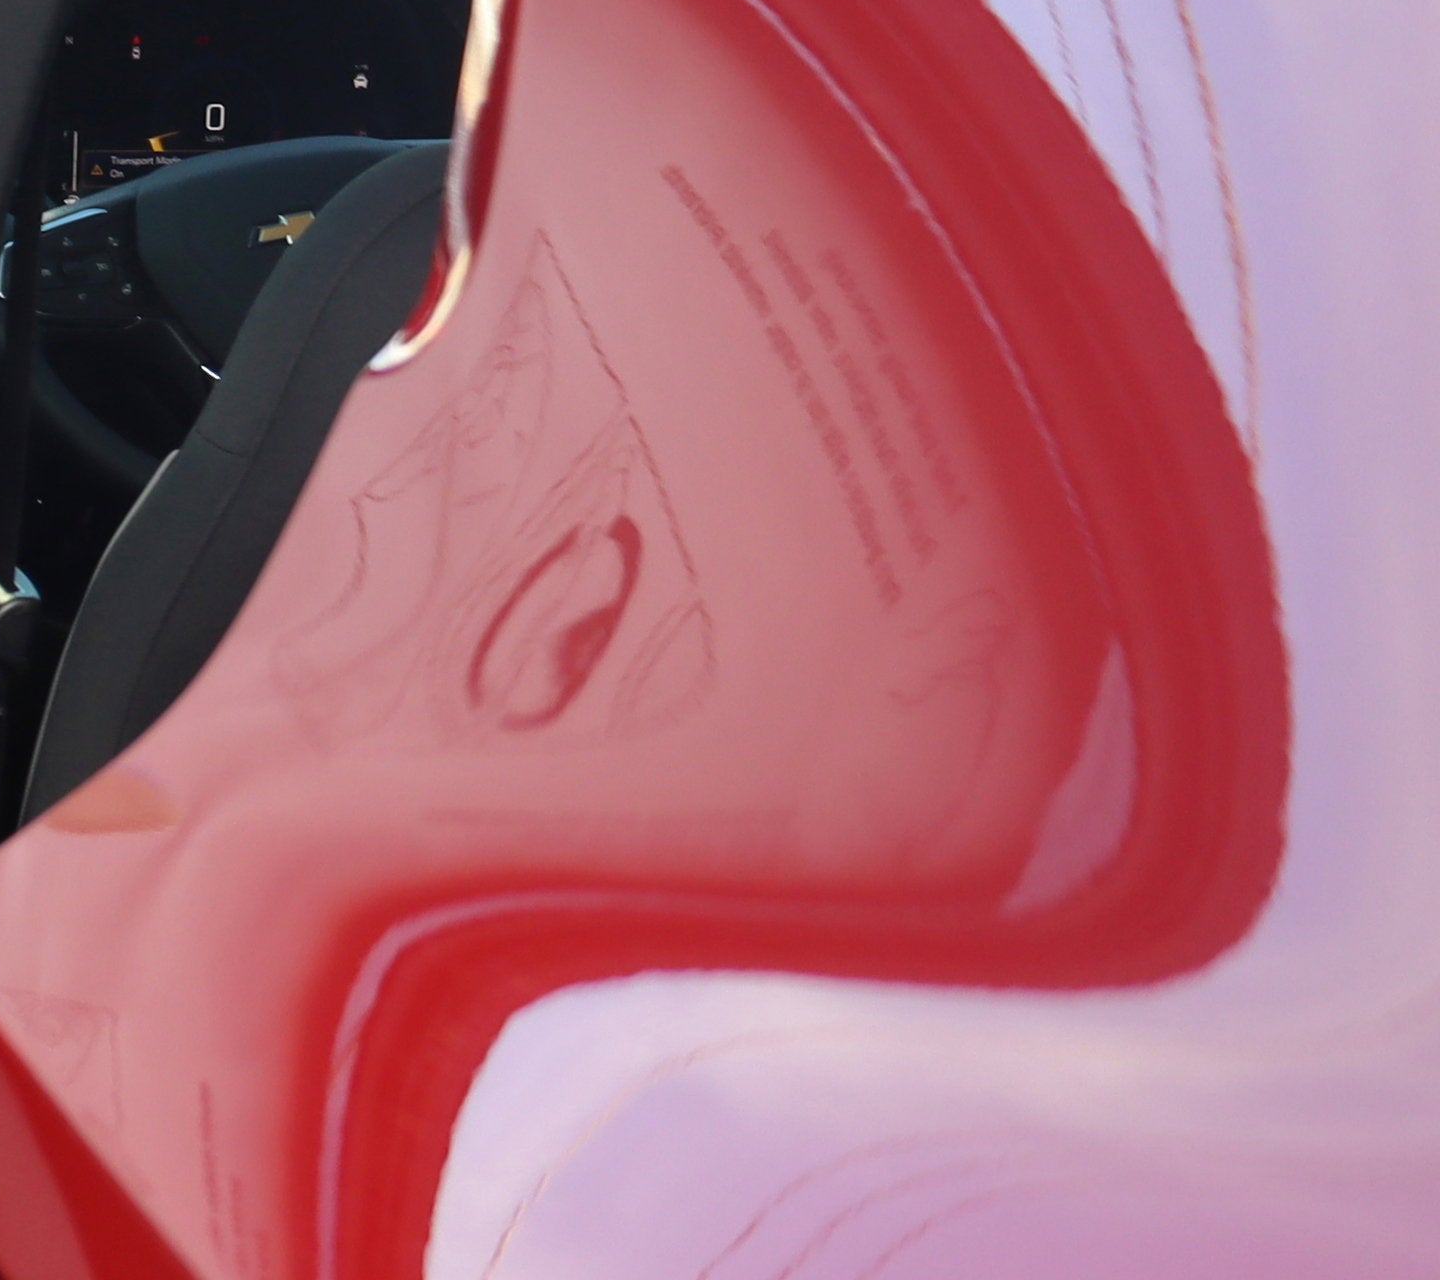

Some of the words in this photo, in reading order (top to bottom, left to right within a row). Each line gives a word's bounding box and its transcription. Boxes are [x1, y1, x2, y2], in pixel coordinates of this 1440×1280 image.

[205, 103, 226, 132] 0
[110, 155, 154, 167] Transport
[109, 169, 125, 179] On
